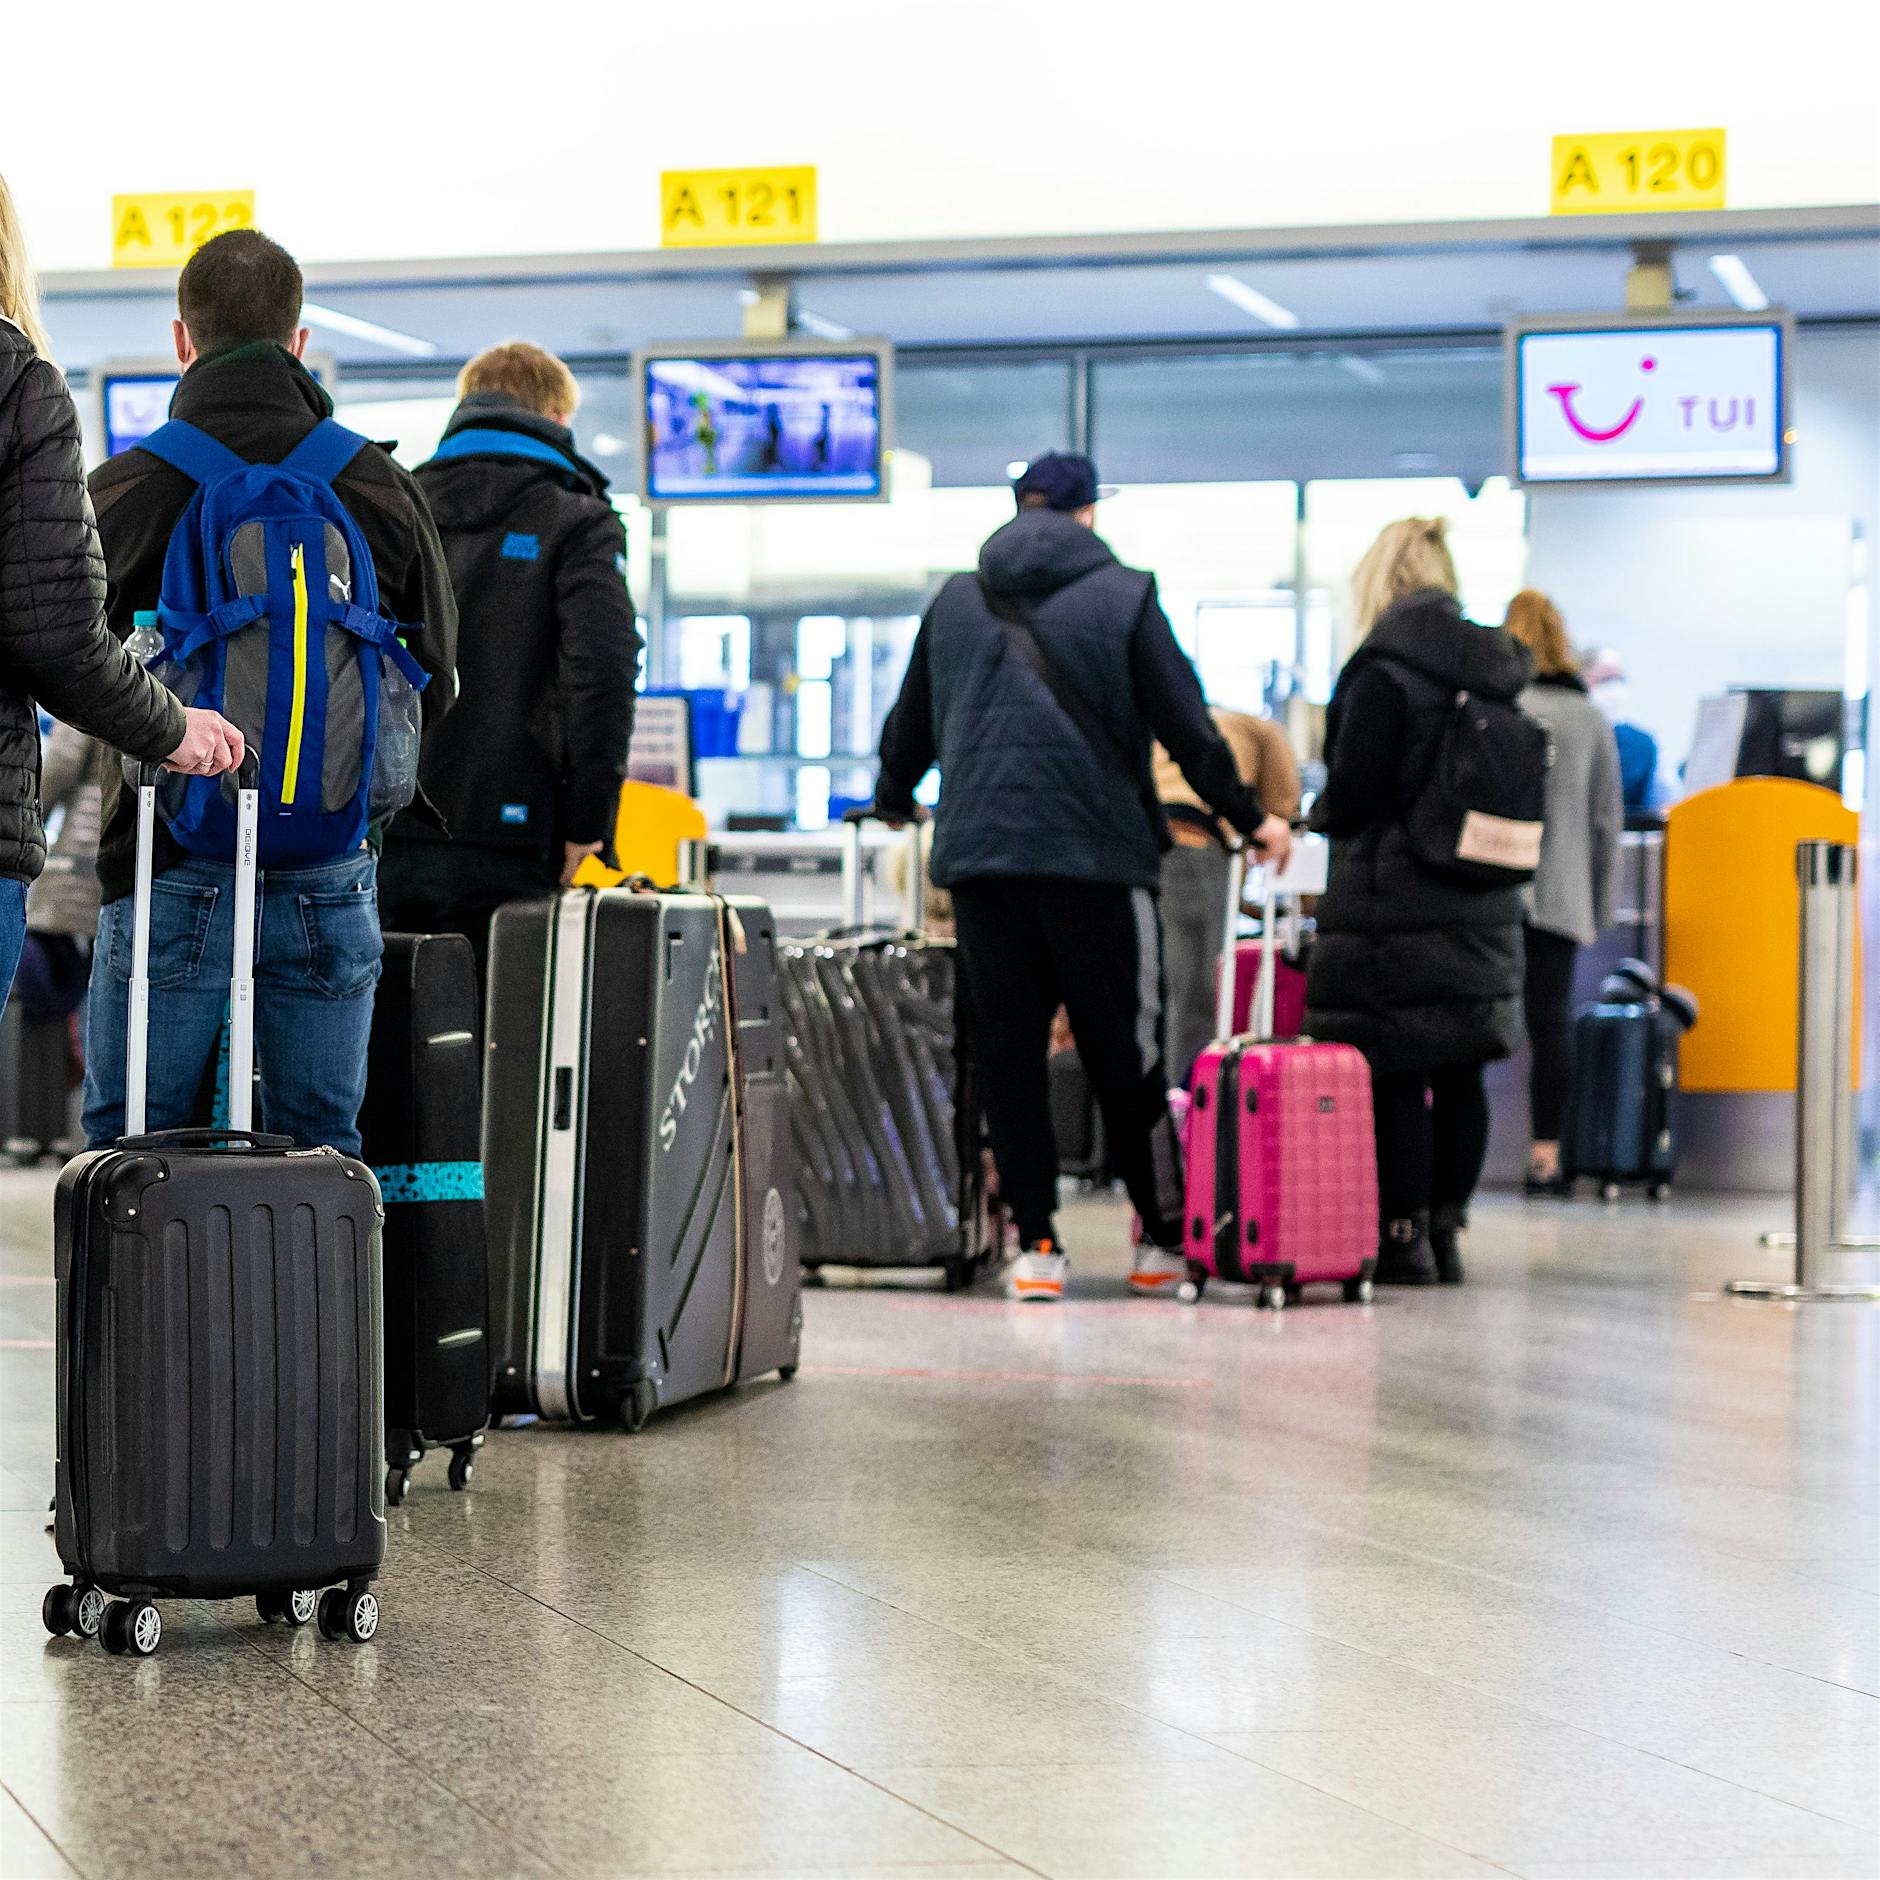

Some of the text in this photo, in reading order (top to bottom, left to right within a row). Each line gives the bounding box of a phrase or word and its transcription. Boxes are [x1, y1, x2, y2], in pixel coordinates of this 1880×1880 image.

[1557, 141, 1723, 196] A 120
[665, 178, 803, 229] A 121
[115, 206, 151, 248] A
[1677, 395, 1756, 432] TUI
